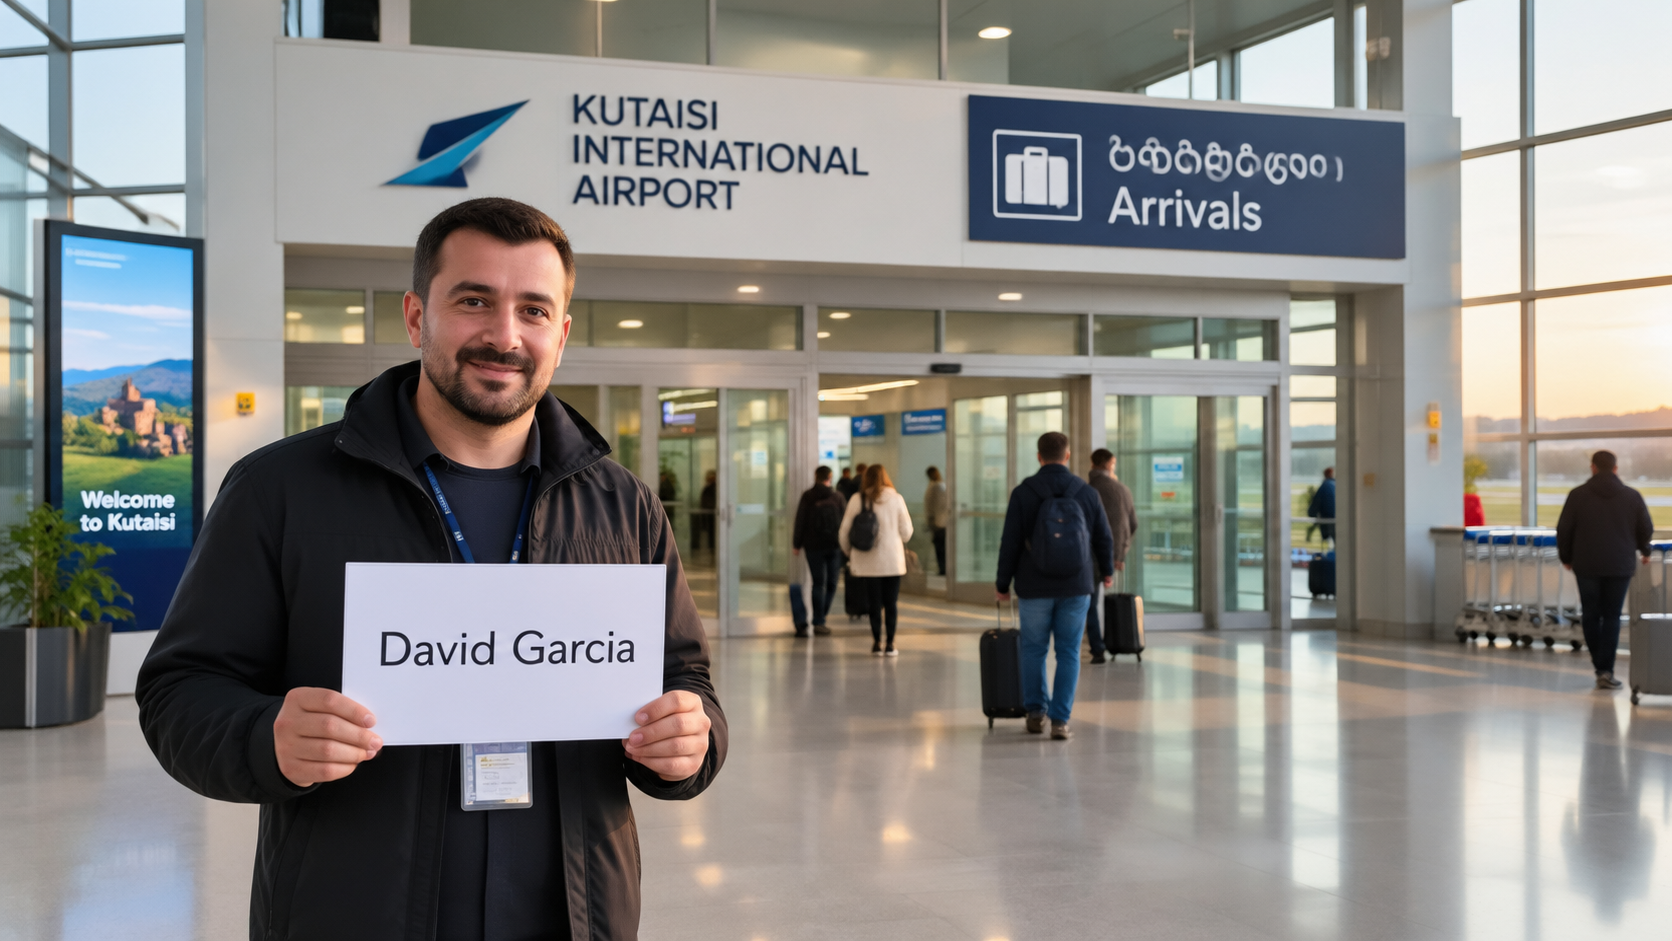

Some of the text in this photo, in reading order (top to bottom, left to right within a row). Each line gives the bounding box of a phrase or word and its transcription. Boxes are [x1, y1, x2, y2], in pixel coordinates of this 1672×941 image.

[572, 94, 718, 131] KUTAISI
[572, 134, 869, 176] INTERNATIONAL
[572, 174, 740, 210] AIRPORT
[1108, 186, 1263, 232] Arrivals
[80, 490, 176, 509] Welcome
[80, 512, 176, 532] to Kutaisi
[380, 629, 635, 667] David Garcia
